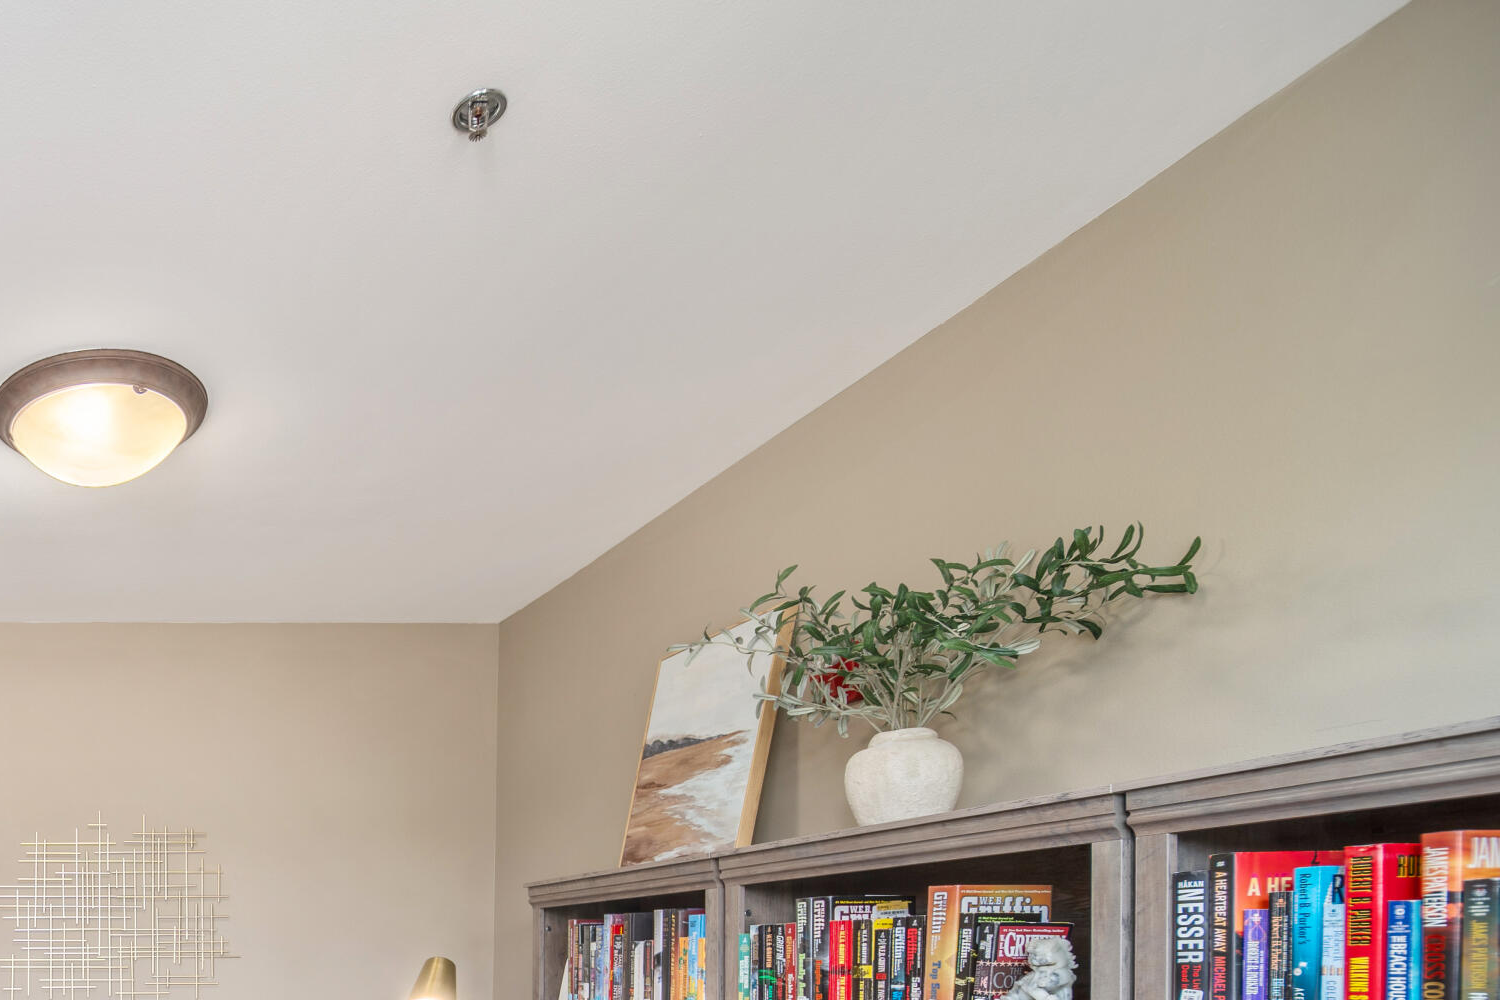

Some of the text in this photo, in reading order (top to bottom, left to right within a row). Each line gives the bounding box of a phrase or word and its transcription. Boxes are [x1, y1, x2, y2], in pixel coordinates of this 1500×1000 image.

[1214, 880, 1228, 928] HEARTBEAT
[1247, 877, 1261, 897] A
[931, 891, 948, 934] Griffin
[1176, 888, 1205, 963] NESSER
[1213, 928, 1227, 953] AWAY
[1213, 956, 1227, 994] MICHAEL
